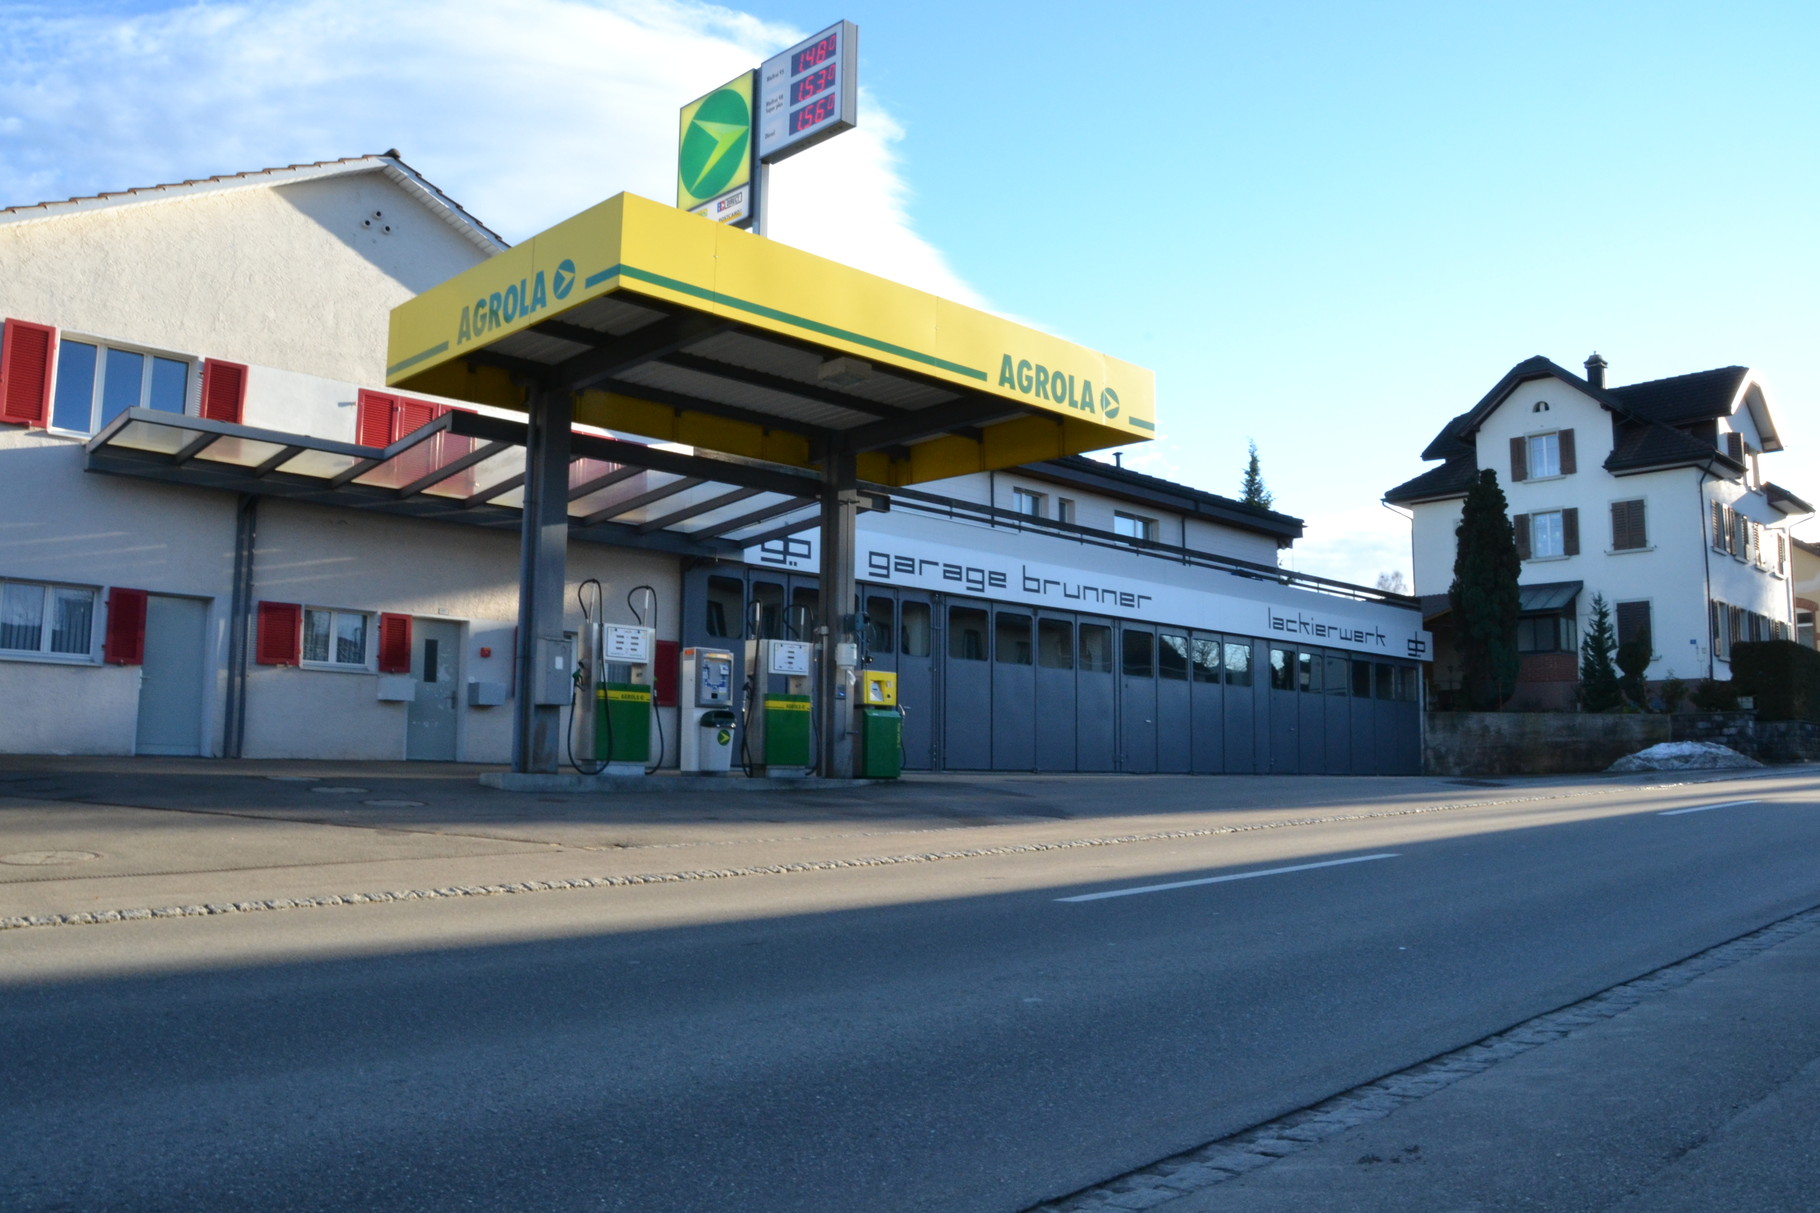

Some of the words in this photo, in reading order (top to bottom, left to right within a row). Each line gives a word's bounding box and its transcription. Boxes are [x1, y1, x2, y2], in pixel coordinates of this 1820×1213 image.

[457, 270, 547, 346] AGROLA
[998, 353, 1096, 414] AGROLA
[867, 550, 1007, 594] garage
[1021, 564, 1153, 609] brunner
[1268, 606, 1386, 647] lackierwerk
